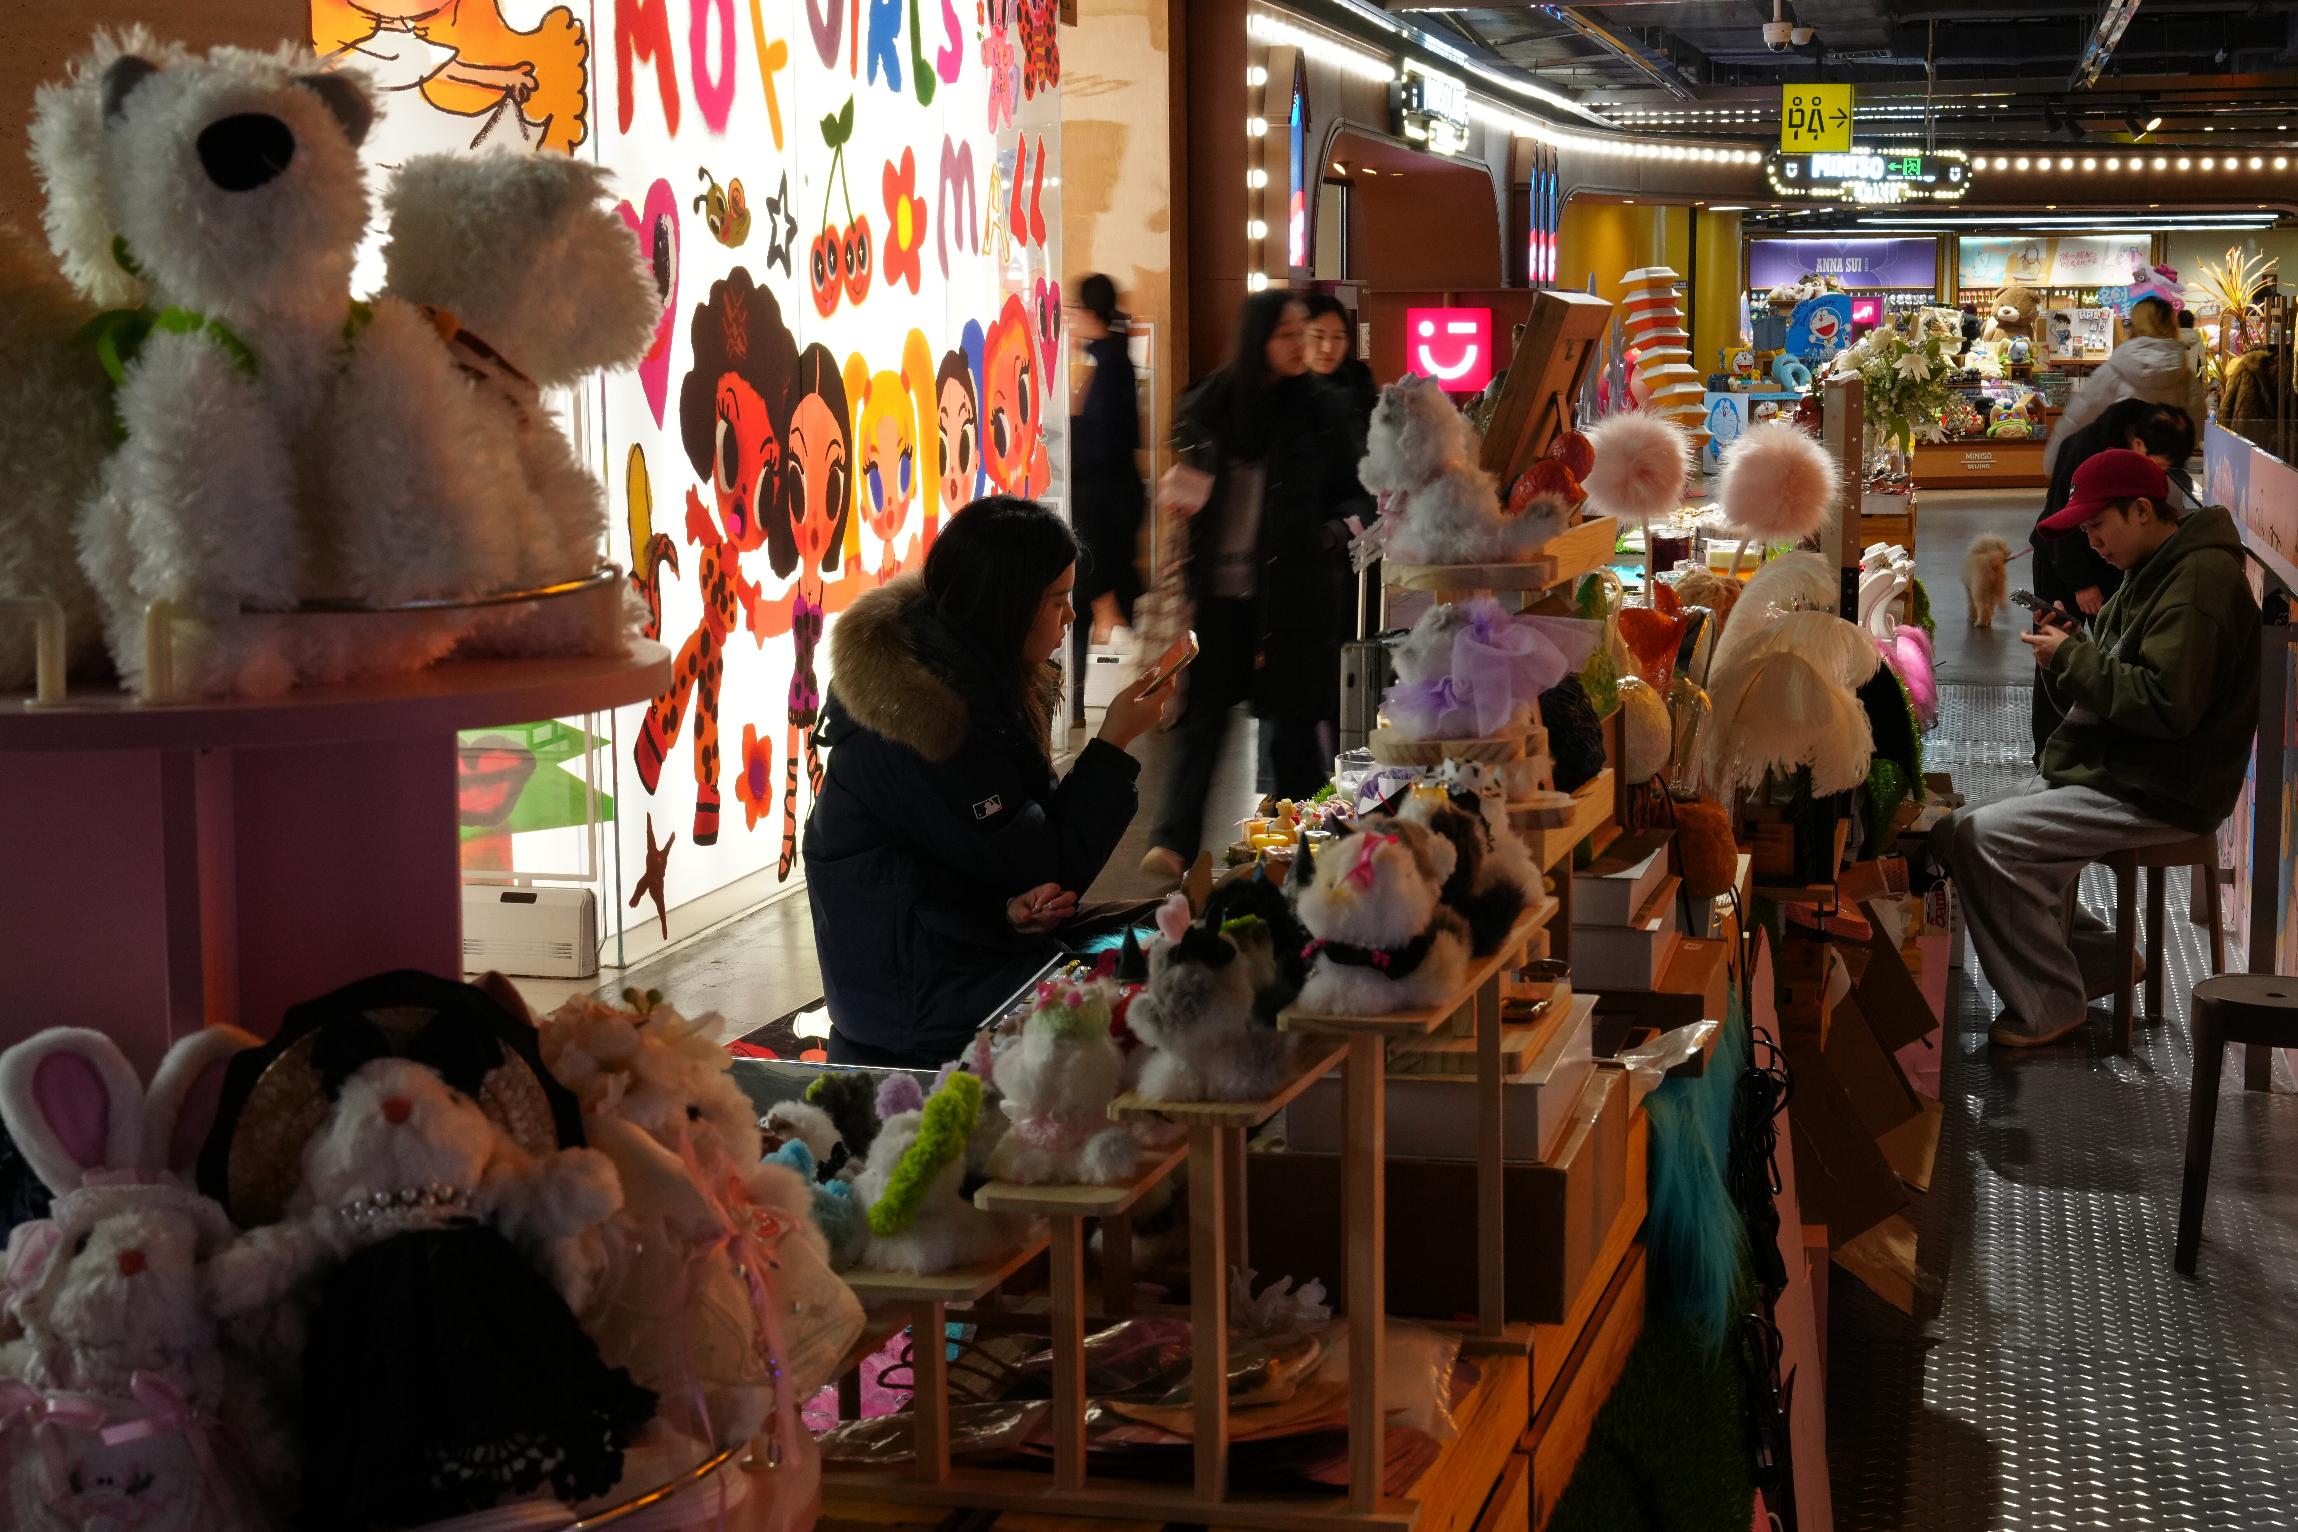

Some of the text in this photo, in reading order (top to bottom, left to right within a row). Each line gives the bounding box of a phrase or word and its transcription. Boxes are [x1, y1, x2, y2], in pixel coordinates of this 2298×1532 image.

[1811, 154, 1885, 180] MINISO
[1816, 258, 1843, 272] ANNA
[1846, 258, 1862, 272] SUI
[1965, 452, 1992, 460] MINISO
